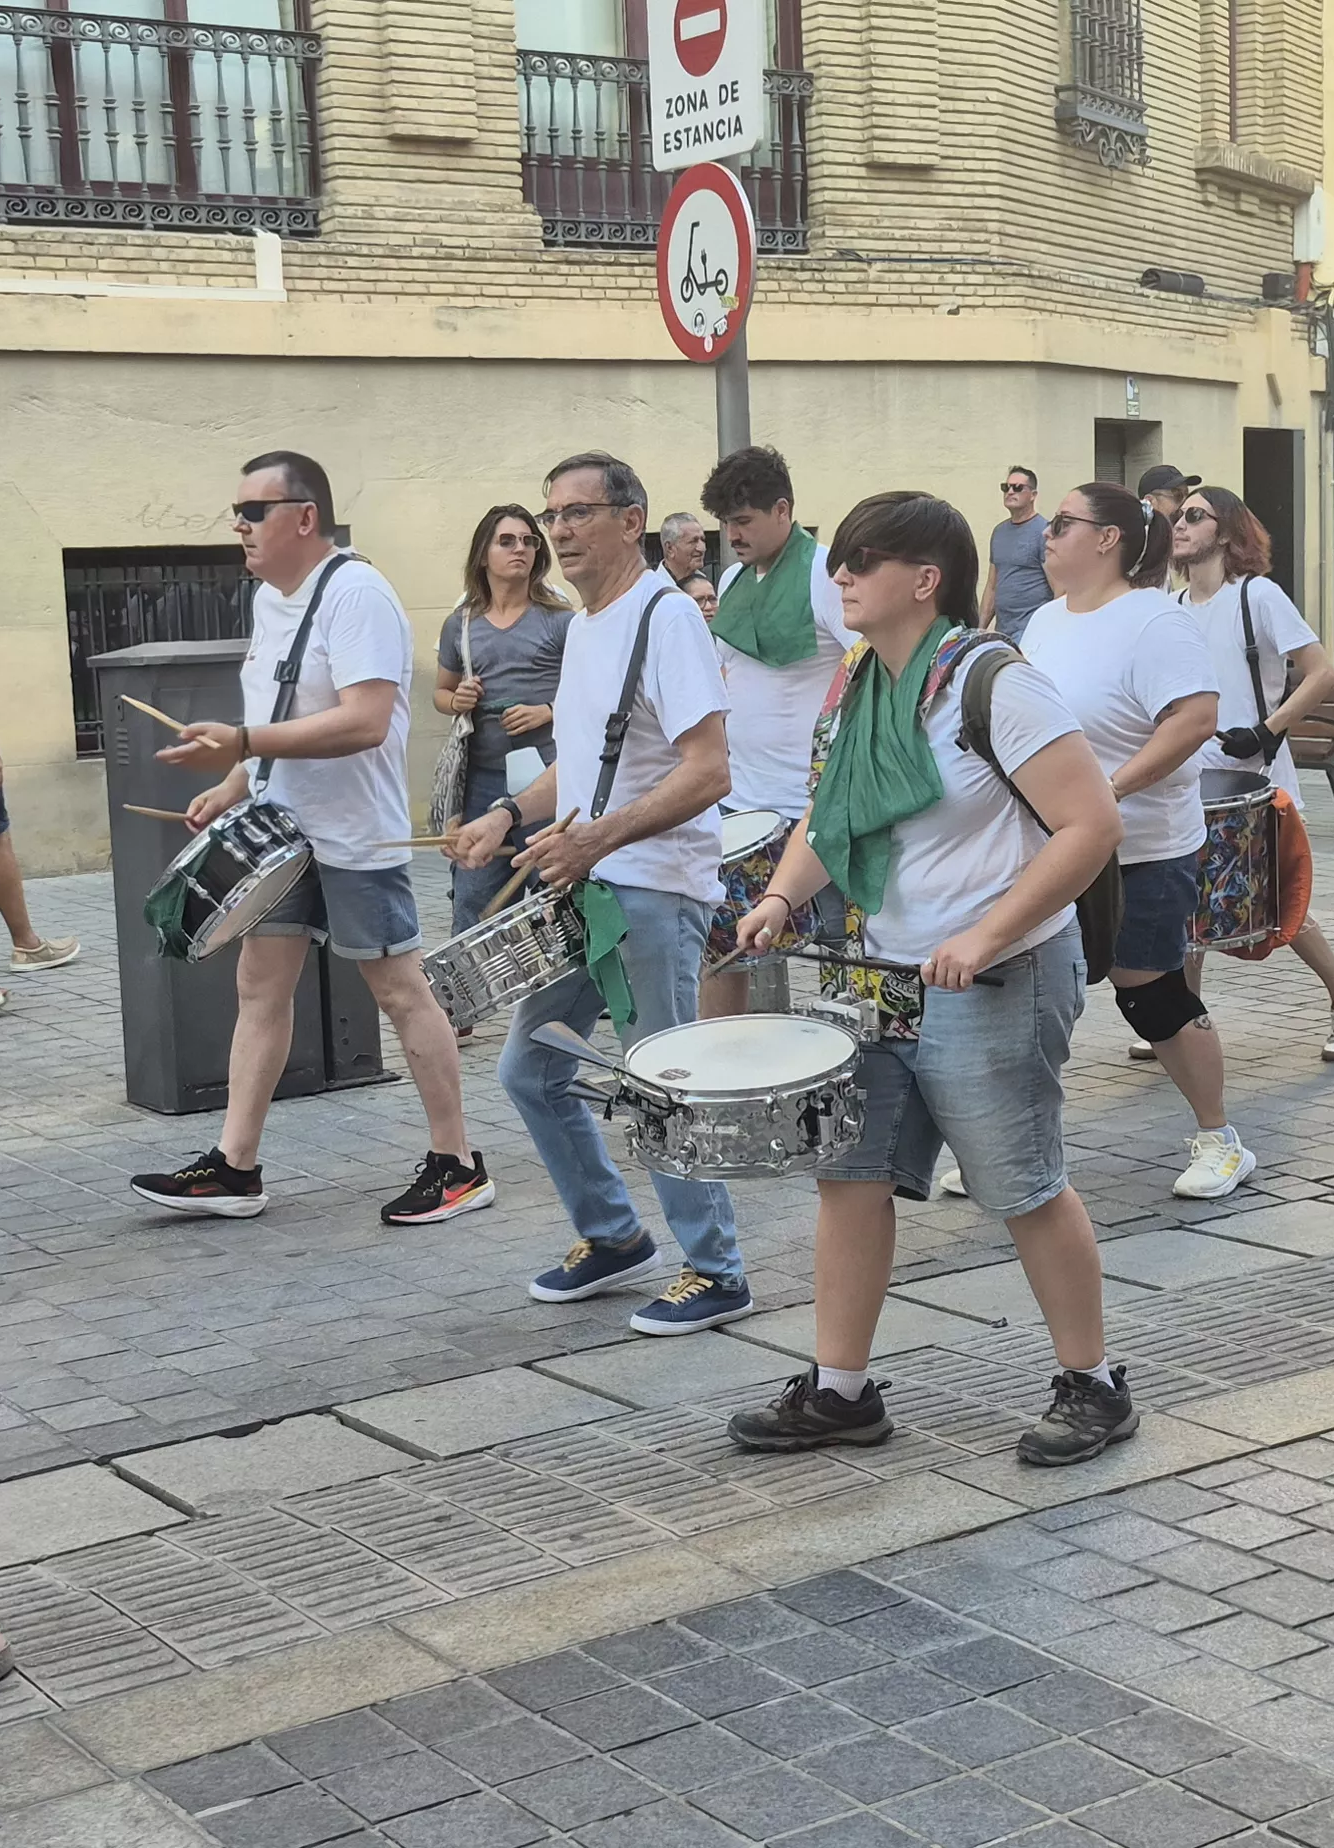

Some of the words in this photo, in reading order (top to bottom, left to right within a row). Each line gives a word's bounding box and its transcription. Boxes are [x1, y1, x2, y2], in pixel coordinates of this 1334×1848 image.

[665, 89, 709, 119] ZONA
[718, 80, 740, 106] DE
[663, 115, 744, 154] ESTANCIA
